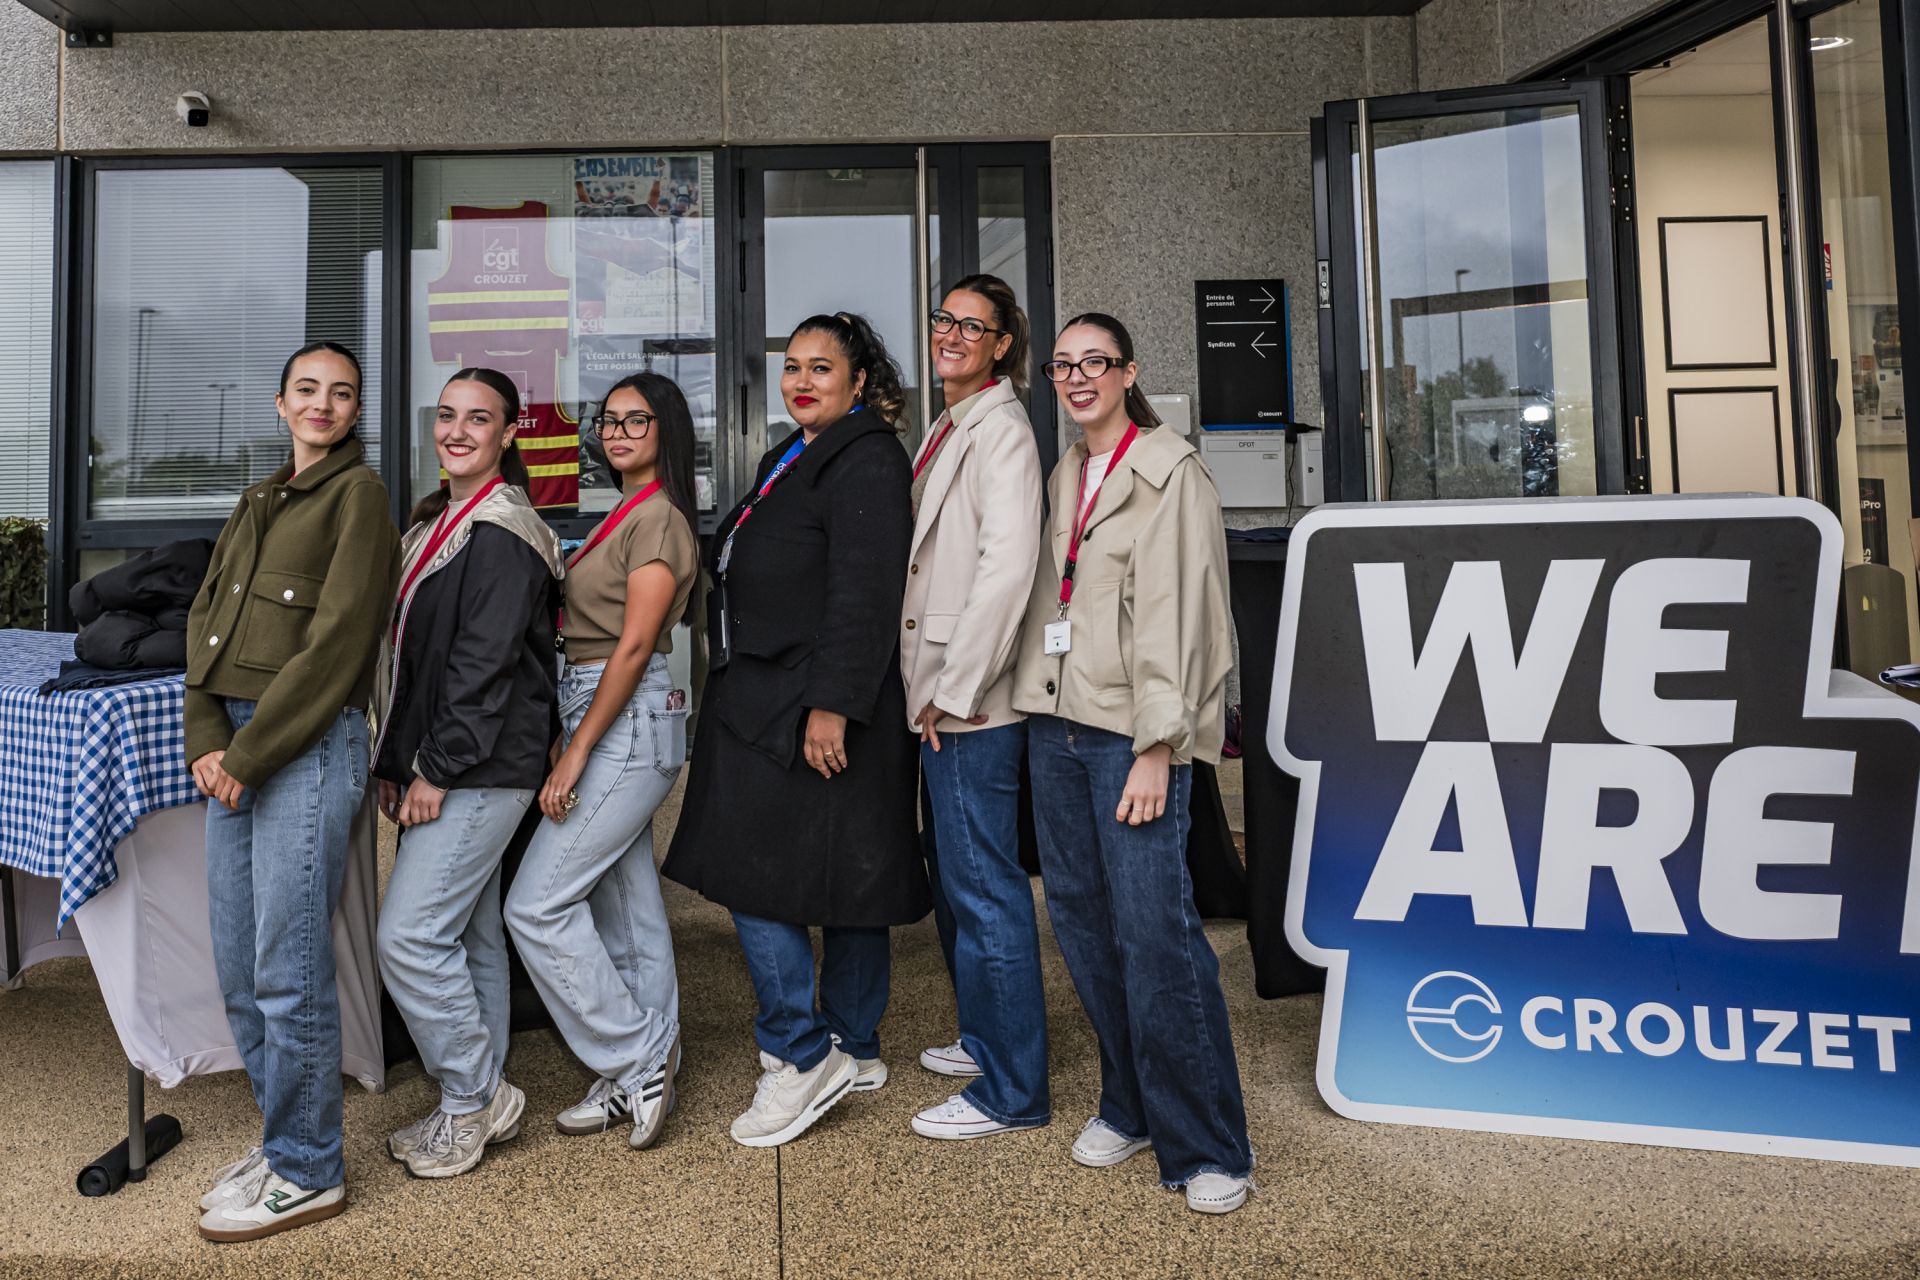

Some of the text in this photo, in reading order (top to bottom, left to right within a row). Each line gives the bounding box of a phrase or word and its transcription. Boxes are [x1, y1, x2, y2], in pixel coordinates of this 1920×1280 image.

[483, 248, 519, 270] cgt
[474, 274, 528, 284] CROUZET
[1860, 500, 1881, 509] iPro
[1353, 557, 1751, 746] WE
[1353, 741, 1857, 940] ARE
[1520, 996, 1911, 1072] CROUZET
[455, 1128, 476, 1143] N
